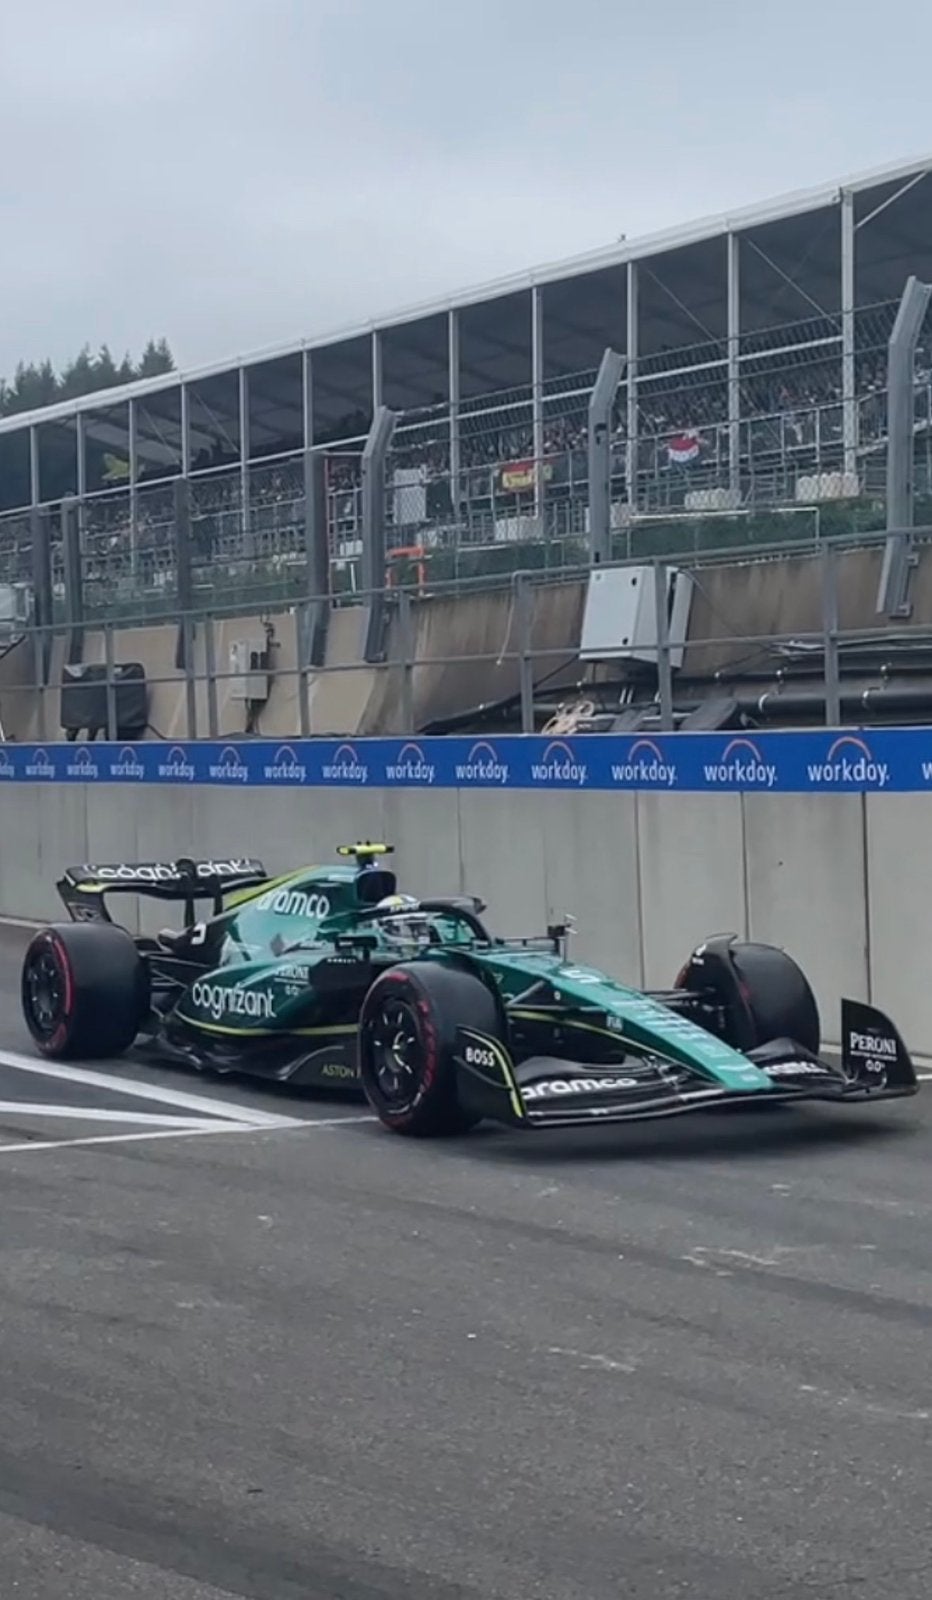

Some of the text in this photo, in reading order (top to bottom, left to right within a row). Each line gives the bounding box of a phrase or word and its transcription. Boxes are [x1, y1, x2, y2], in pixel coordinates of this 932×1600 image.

[97, 860, 244, 880] cogniant
[192, 982, 276, 1019] cognizant
[850, 1031, 896, 1054] PERONI
[465, 1047, 495, 1067] BOSS
[522, 1078, 637, 1099] aramco
